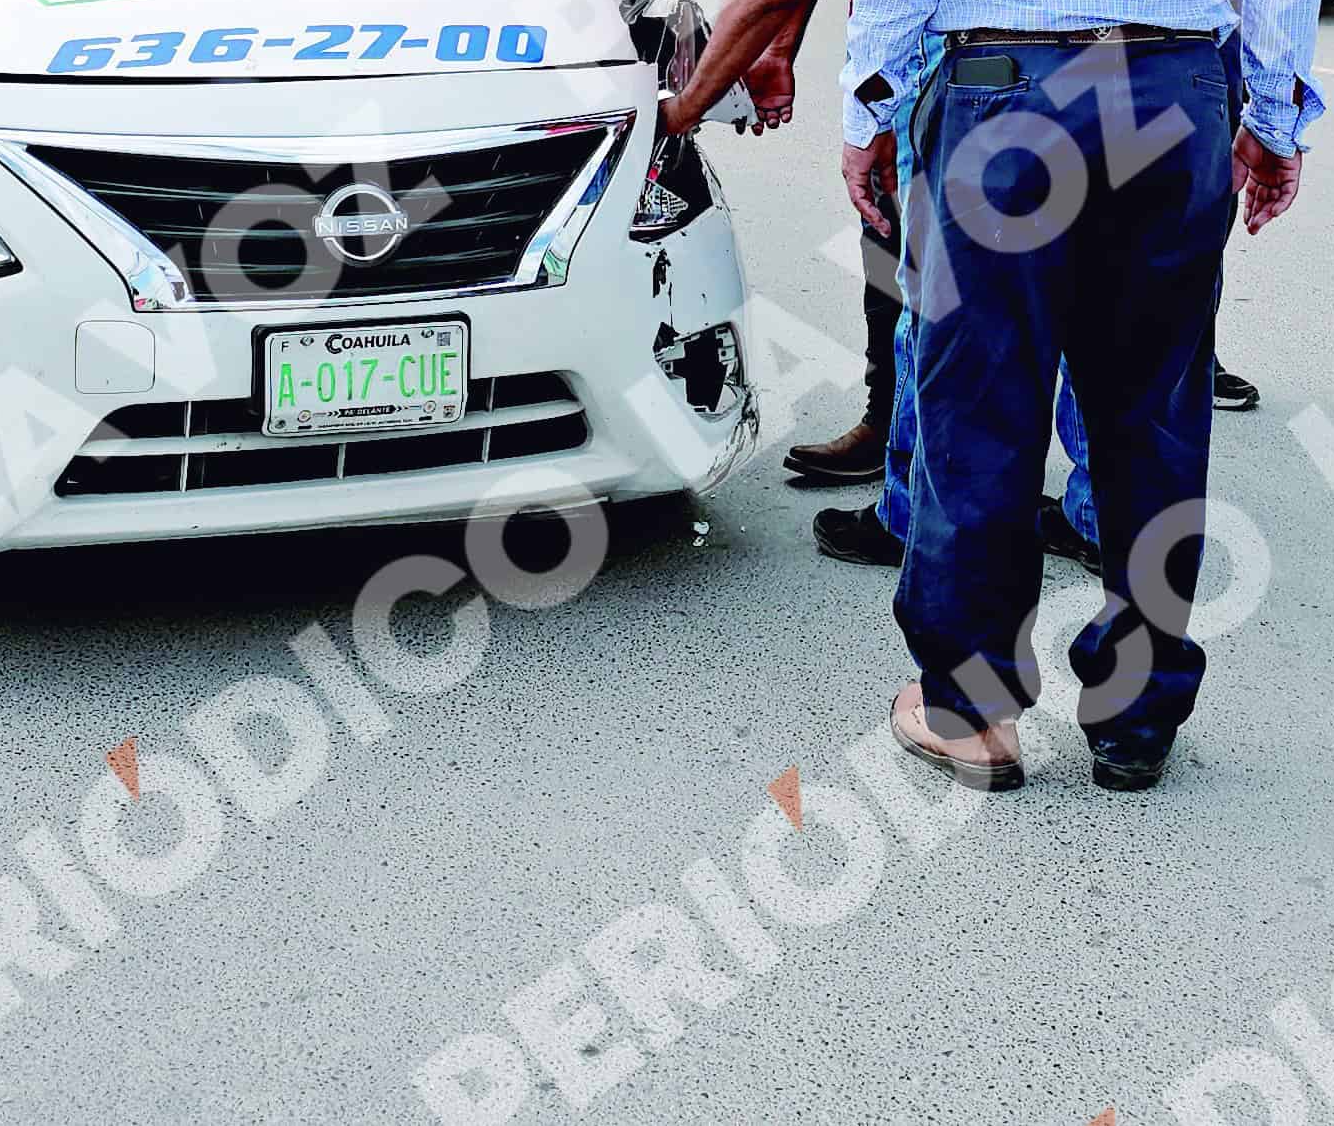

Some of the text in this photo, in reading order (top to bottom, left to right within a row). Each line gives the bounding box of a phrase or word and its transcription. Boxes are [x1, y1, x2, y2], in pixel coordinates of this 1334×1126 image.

[46, 25, 548, 73] 636-27-00
[316, 217, 408, 235] NISSAN
[325, 334, 411, 354] COAHUILA
[278, 353, 457, 407] A-017-CUE
